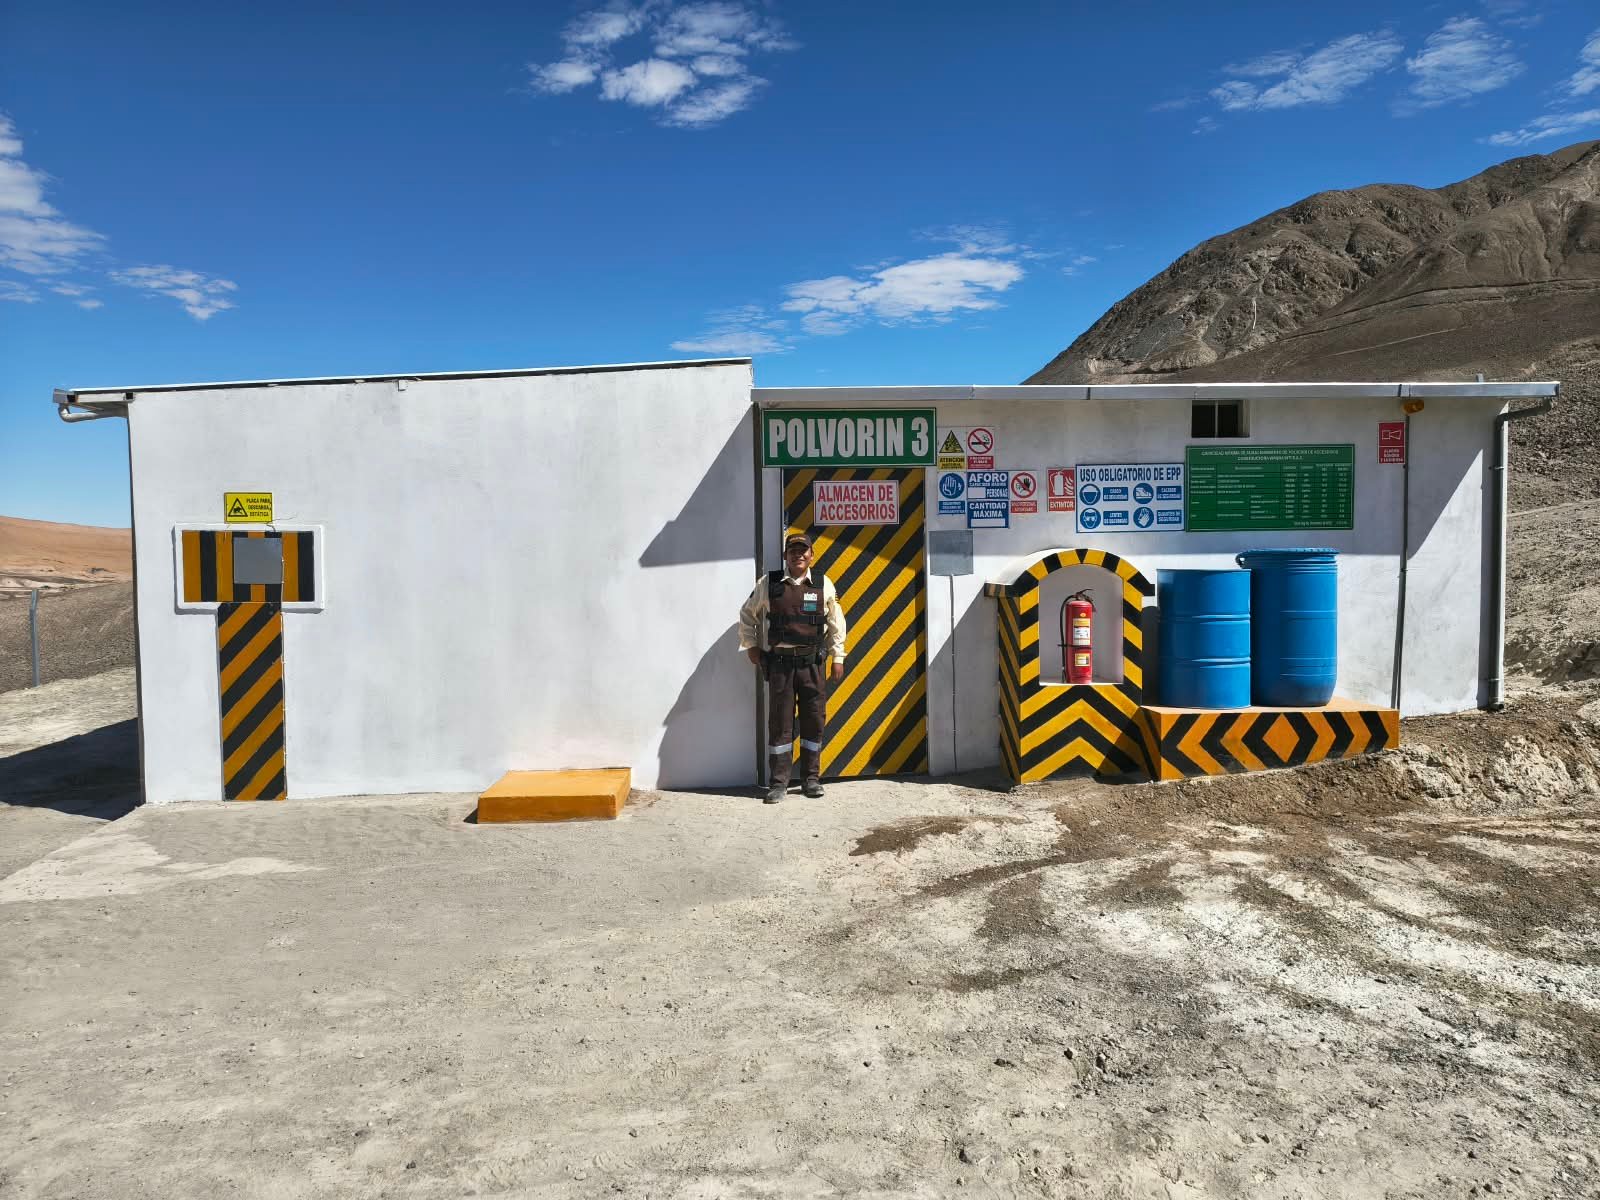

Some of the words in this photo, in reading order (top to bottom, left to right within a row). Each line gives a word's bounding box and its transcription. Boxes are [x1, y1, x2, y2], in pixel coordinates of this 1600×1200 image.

[768, 417, 904, 458] POLVORIN
[911, 416, 929, 457] 3
[969, 472, 1008, 483] AFORO
[1080, 468, 1097, 482] USO
[1098, 467, 1152, 481] OBLIGATORIO
[1153, 467, 1164, 481] DE
[1166, 467, 1181, 480] EPP
[818, 485, 875, 502] ALMACEN
[878, 485, 893, 501] DE
[820, 503, 896, 521] ACCESORIOS
[969, 502, 1007, 510] CANTIDAD
